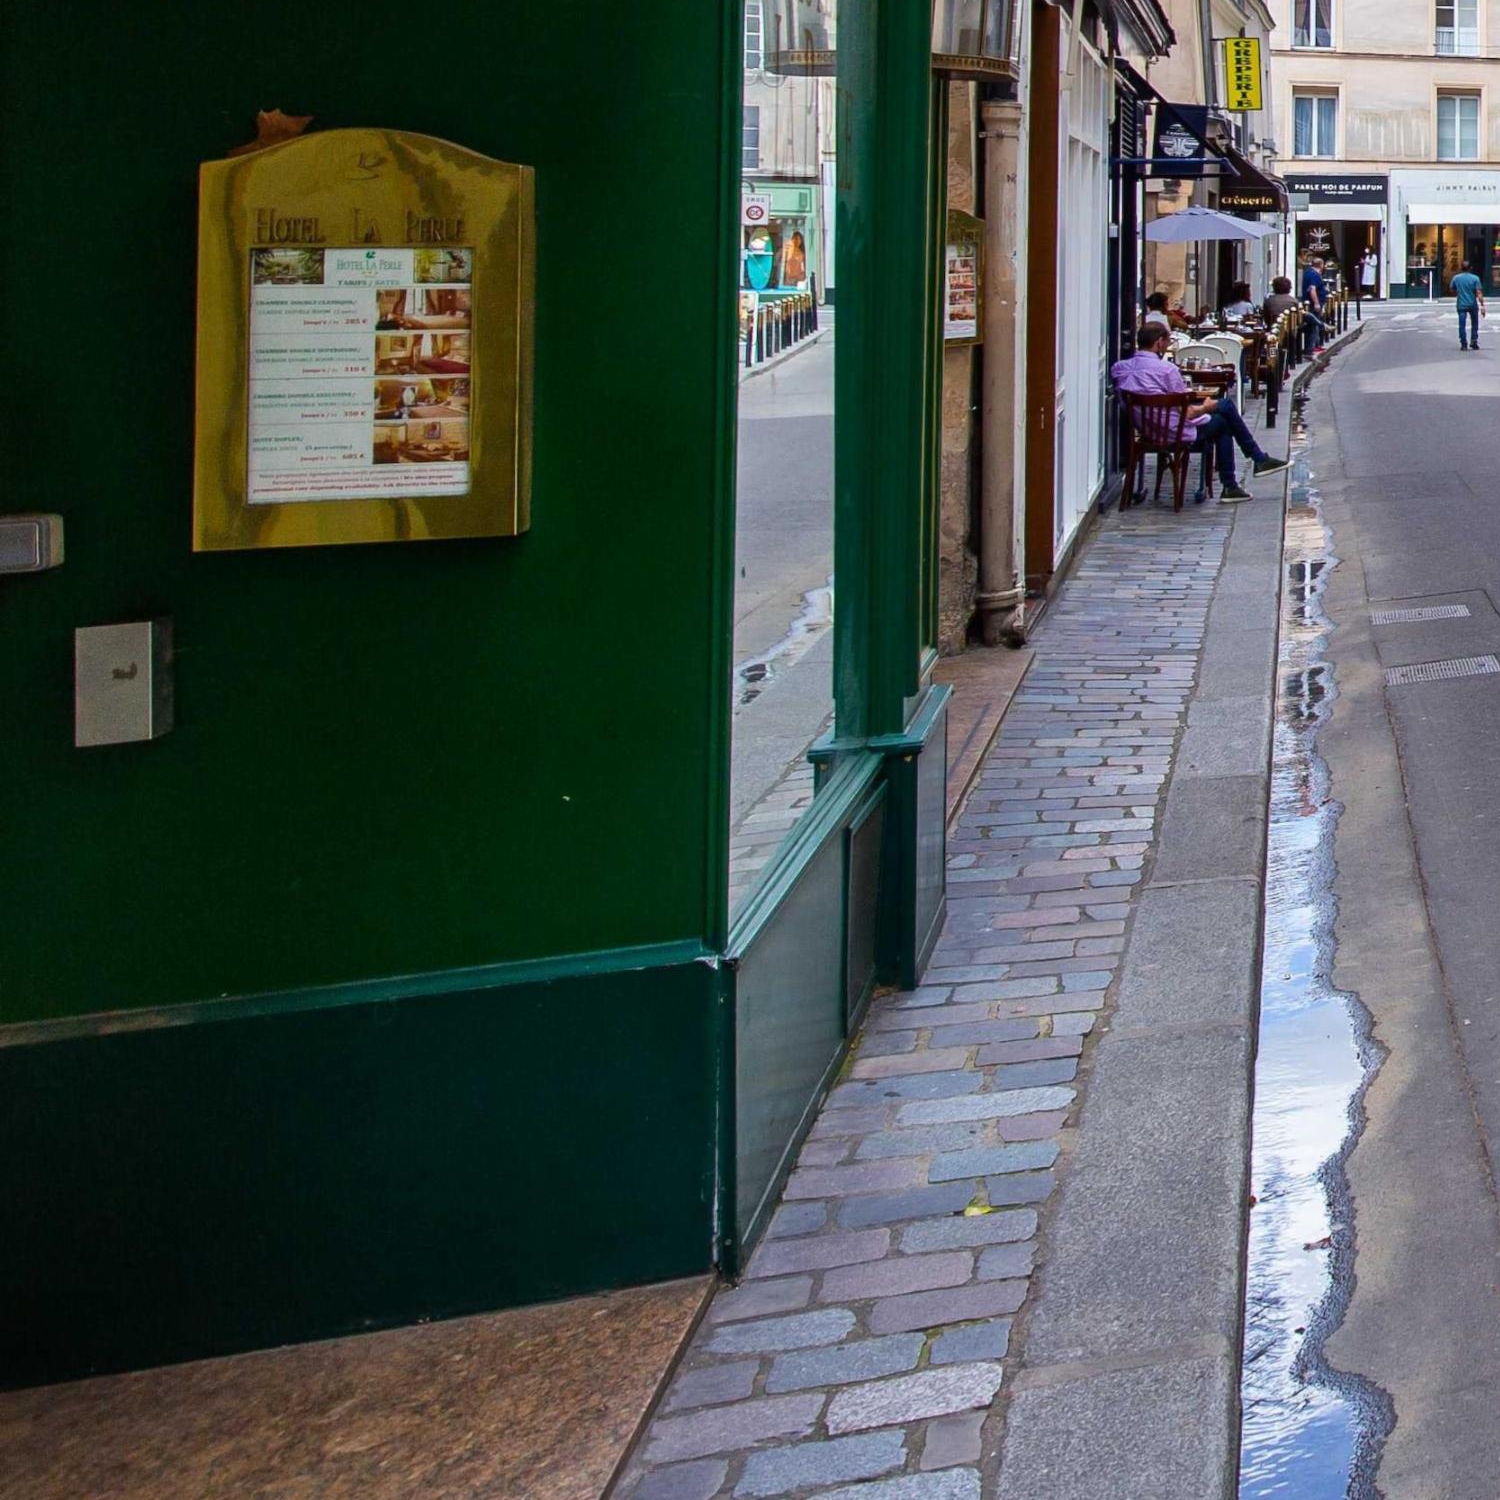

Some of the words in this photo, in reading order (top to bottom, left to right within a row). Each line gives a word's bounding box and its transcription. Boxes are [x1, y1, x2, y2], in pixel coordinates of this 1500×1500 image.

[254, 207, 327, 244] HOTEL
[349, 208, 381, 244] LA
[405, 207, 466, 244] PERLE
[337, 260, 364, 270] HOTEL
[366, 259, 377, 270] LA
[379, 259, 402, 270] PERLE
